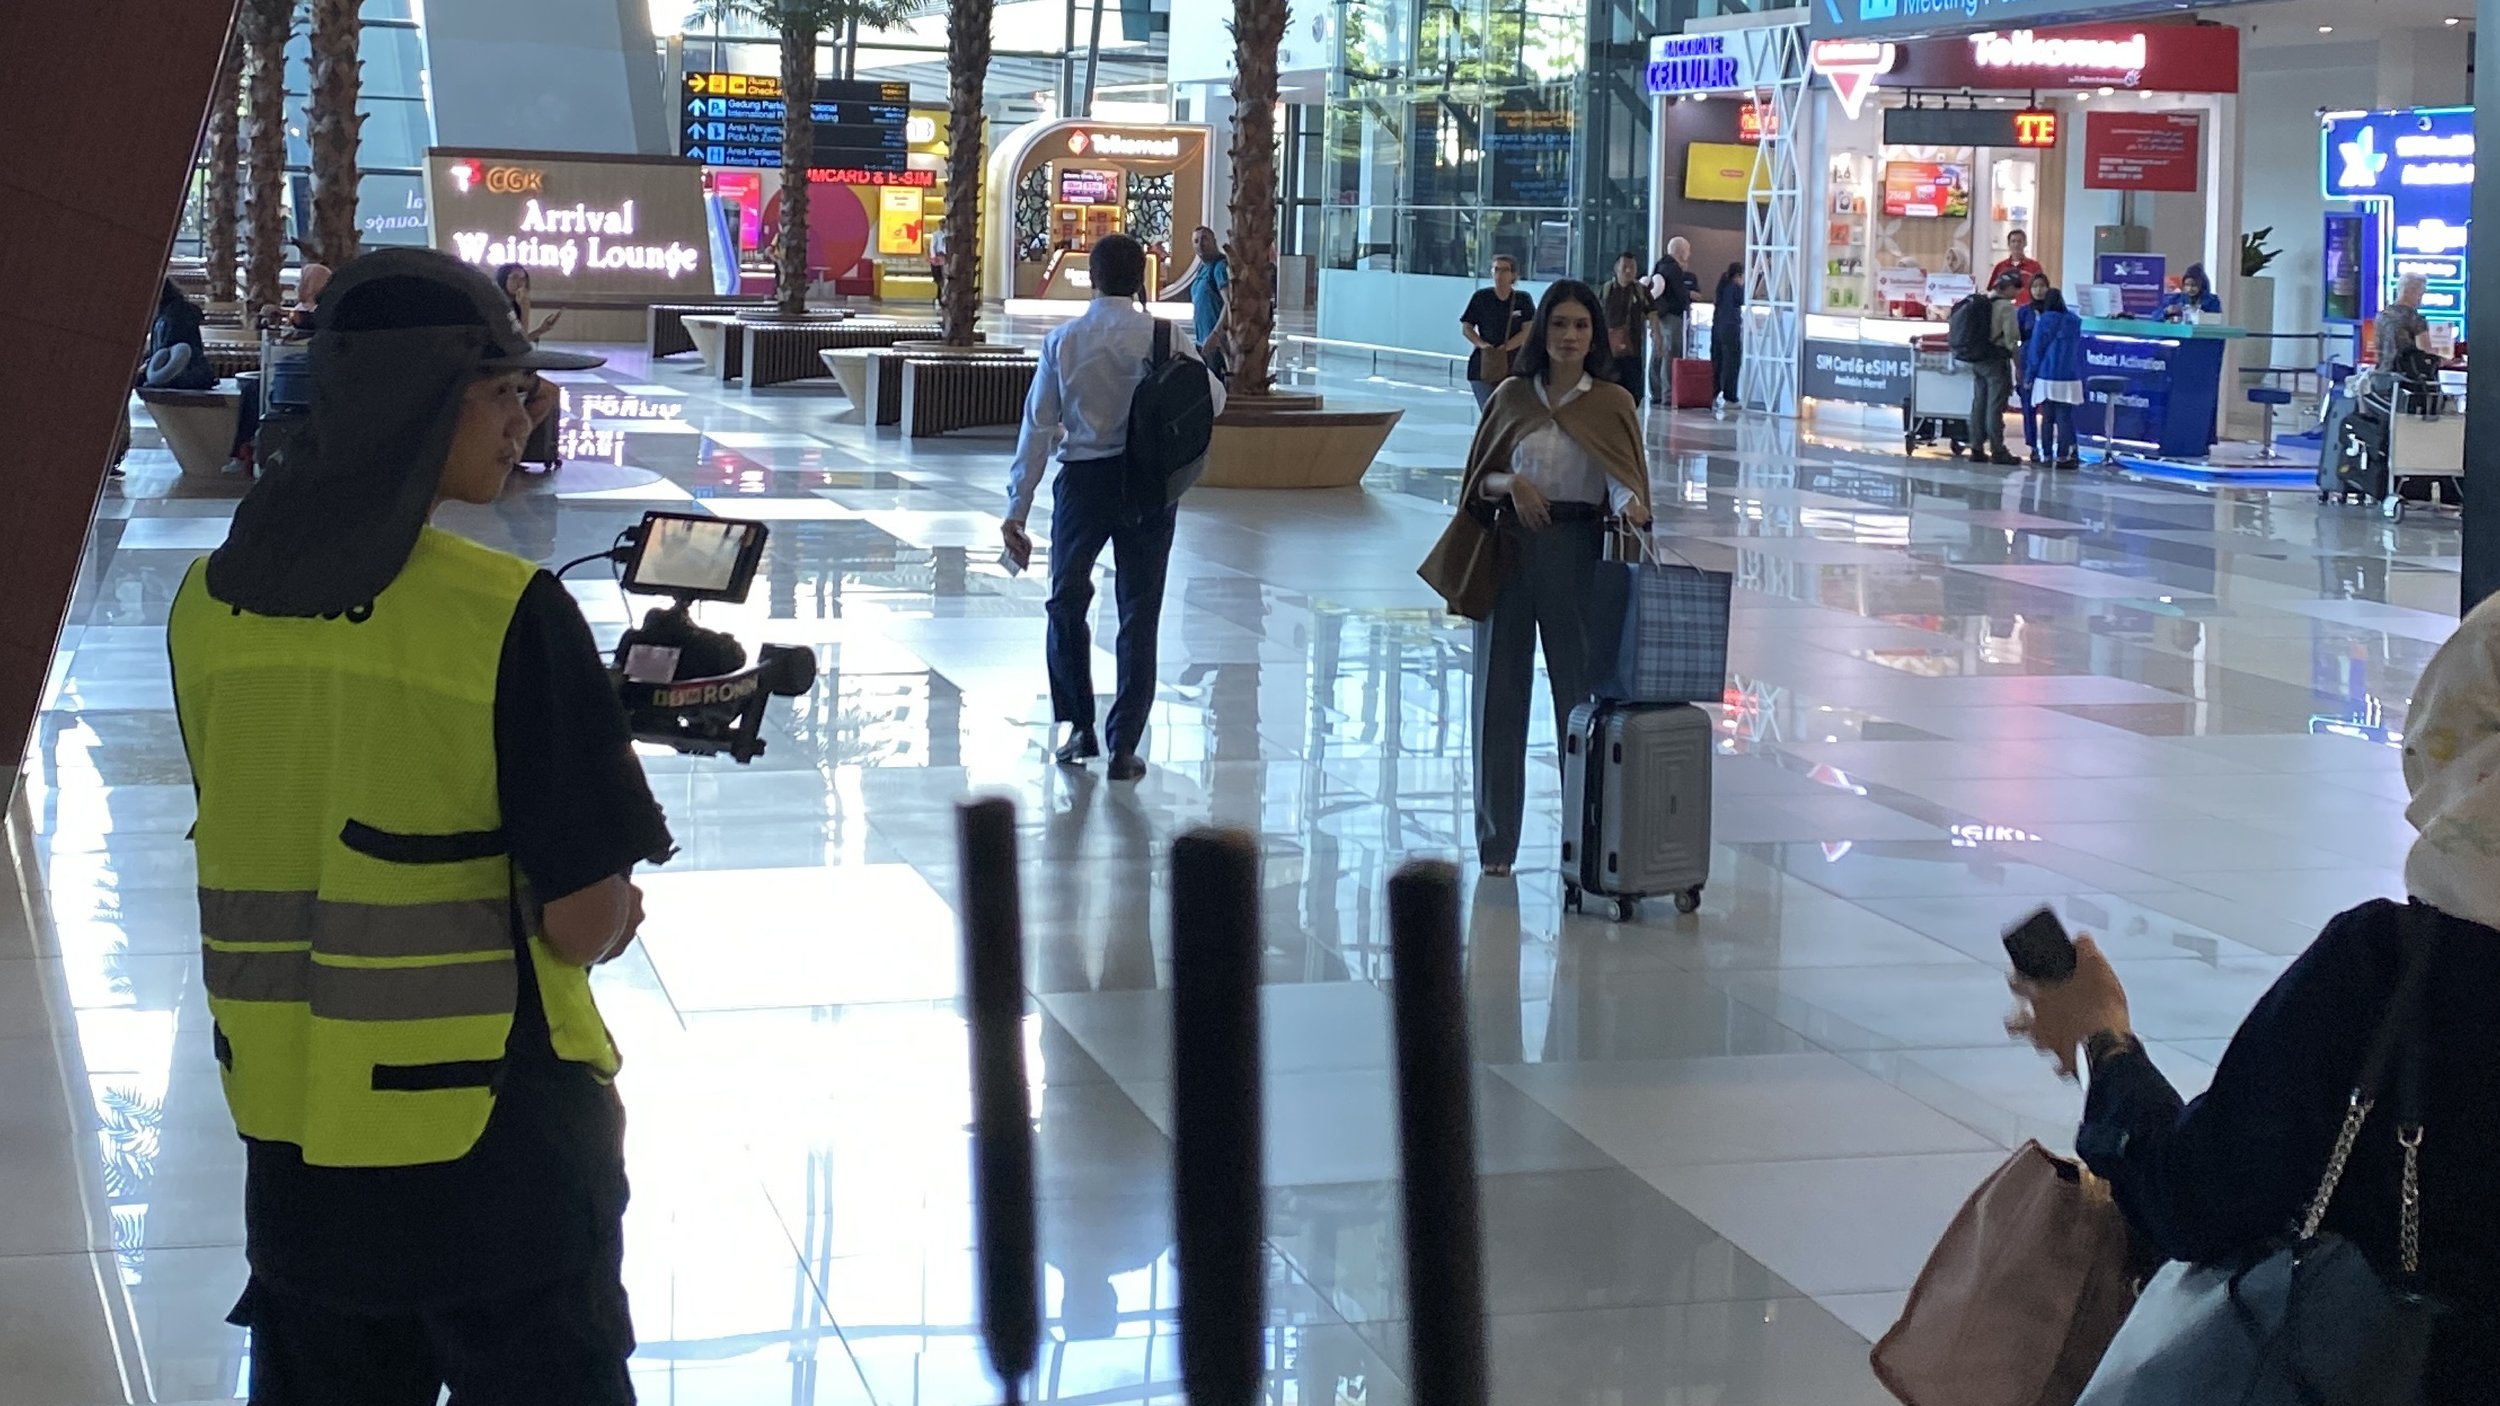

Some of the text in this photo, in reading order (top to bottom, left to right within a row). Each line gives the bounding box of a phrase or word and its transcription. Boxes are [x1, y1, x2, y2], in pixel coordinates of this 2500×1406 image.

[1646, 57, 1739, 92] CELLULAR
[728, 99, 761, 111] Gedung
[727, 133, 760, 143] Pick-Up
[486, 166, 543, 193] CGK
[520, 199, 634, 234] Arrival
[452, 231, 698, 279] Waiting Lounge
[1816, 354, 1833, 370] SIM
[1833, 356, 1855, 373] Card
[1865, 359, 1898, 377] eSIM
[2086, 349, 2166, 371] Instant Activation
